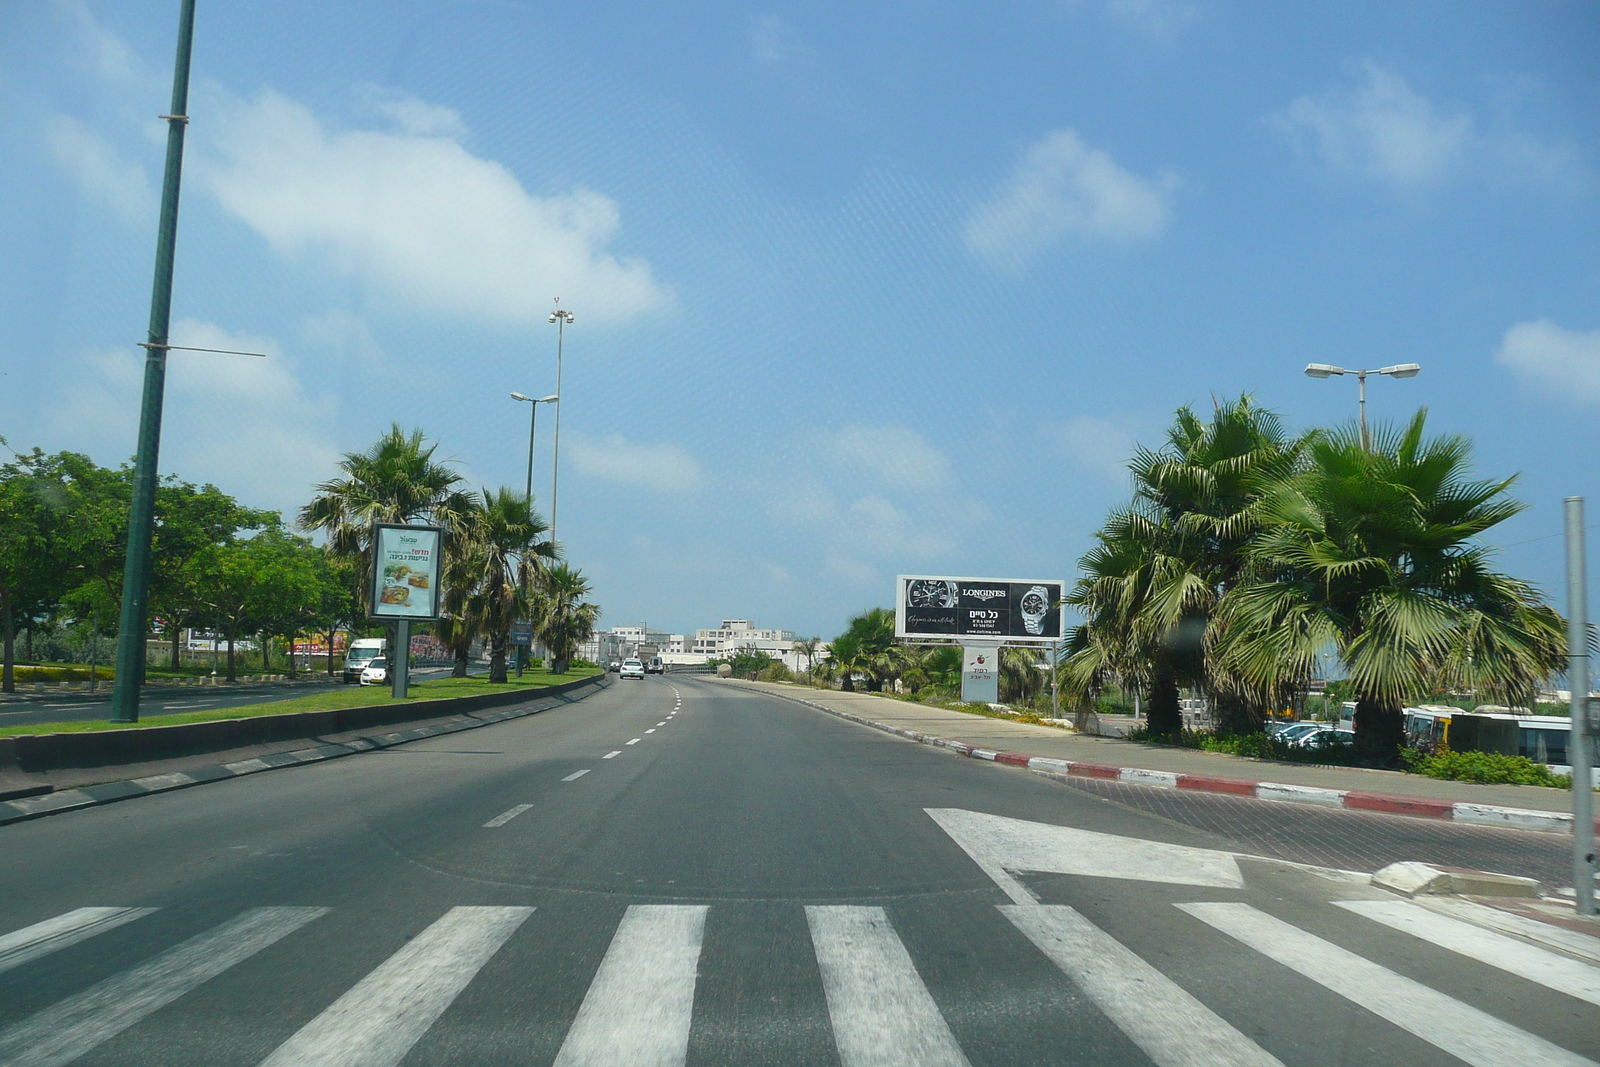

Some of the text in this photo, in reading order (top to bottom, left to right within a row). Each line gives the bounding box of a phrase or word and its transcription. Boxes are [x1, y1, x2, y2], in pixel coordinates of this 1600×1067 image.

[962, 589, 1006, 597] LONGINES
[969, 610, 998, 618] כל טיים
